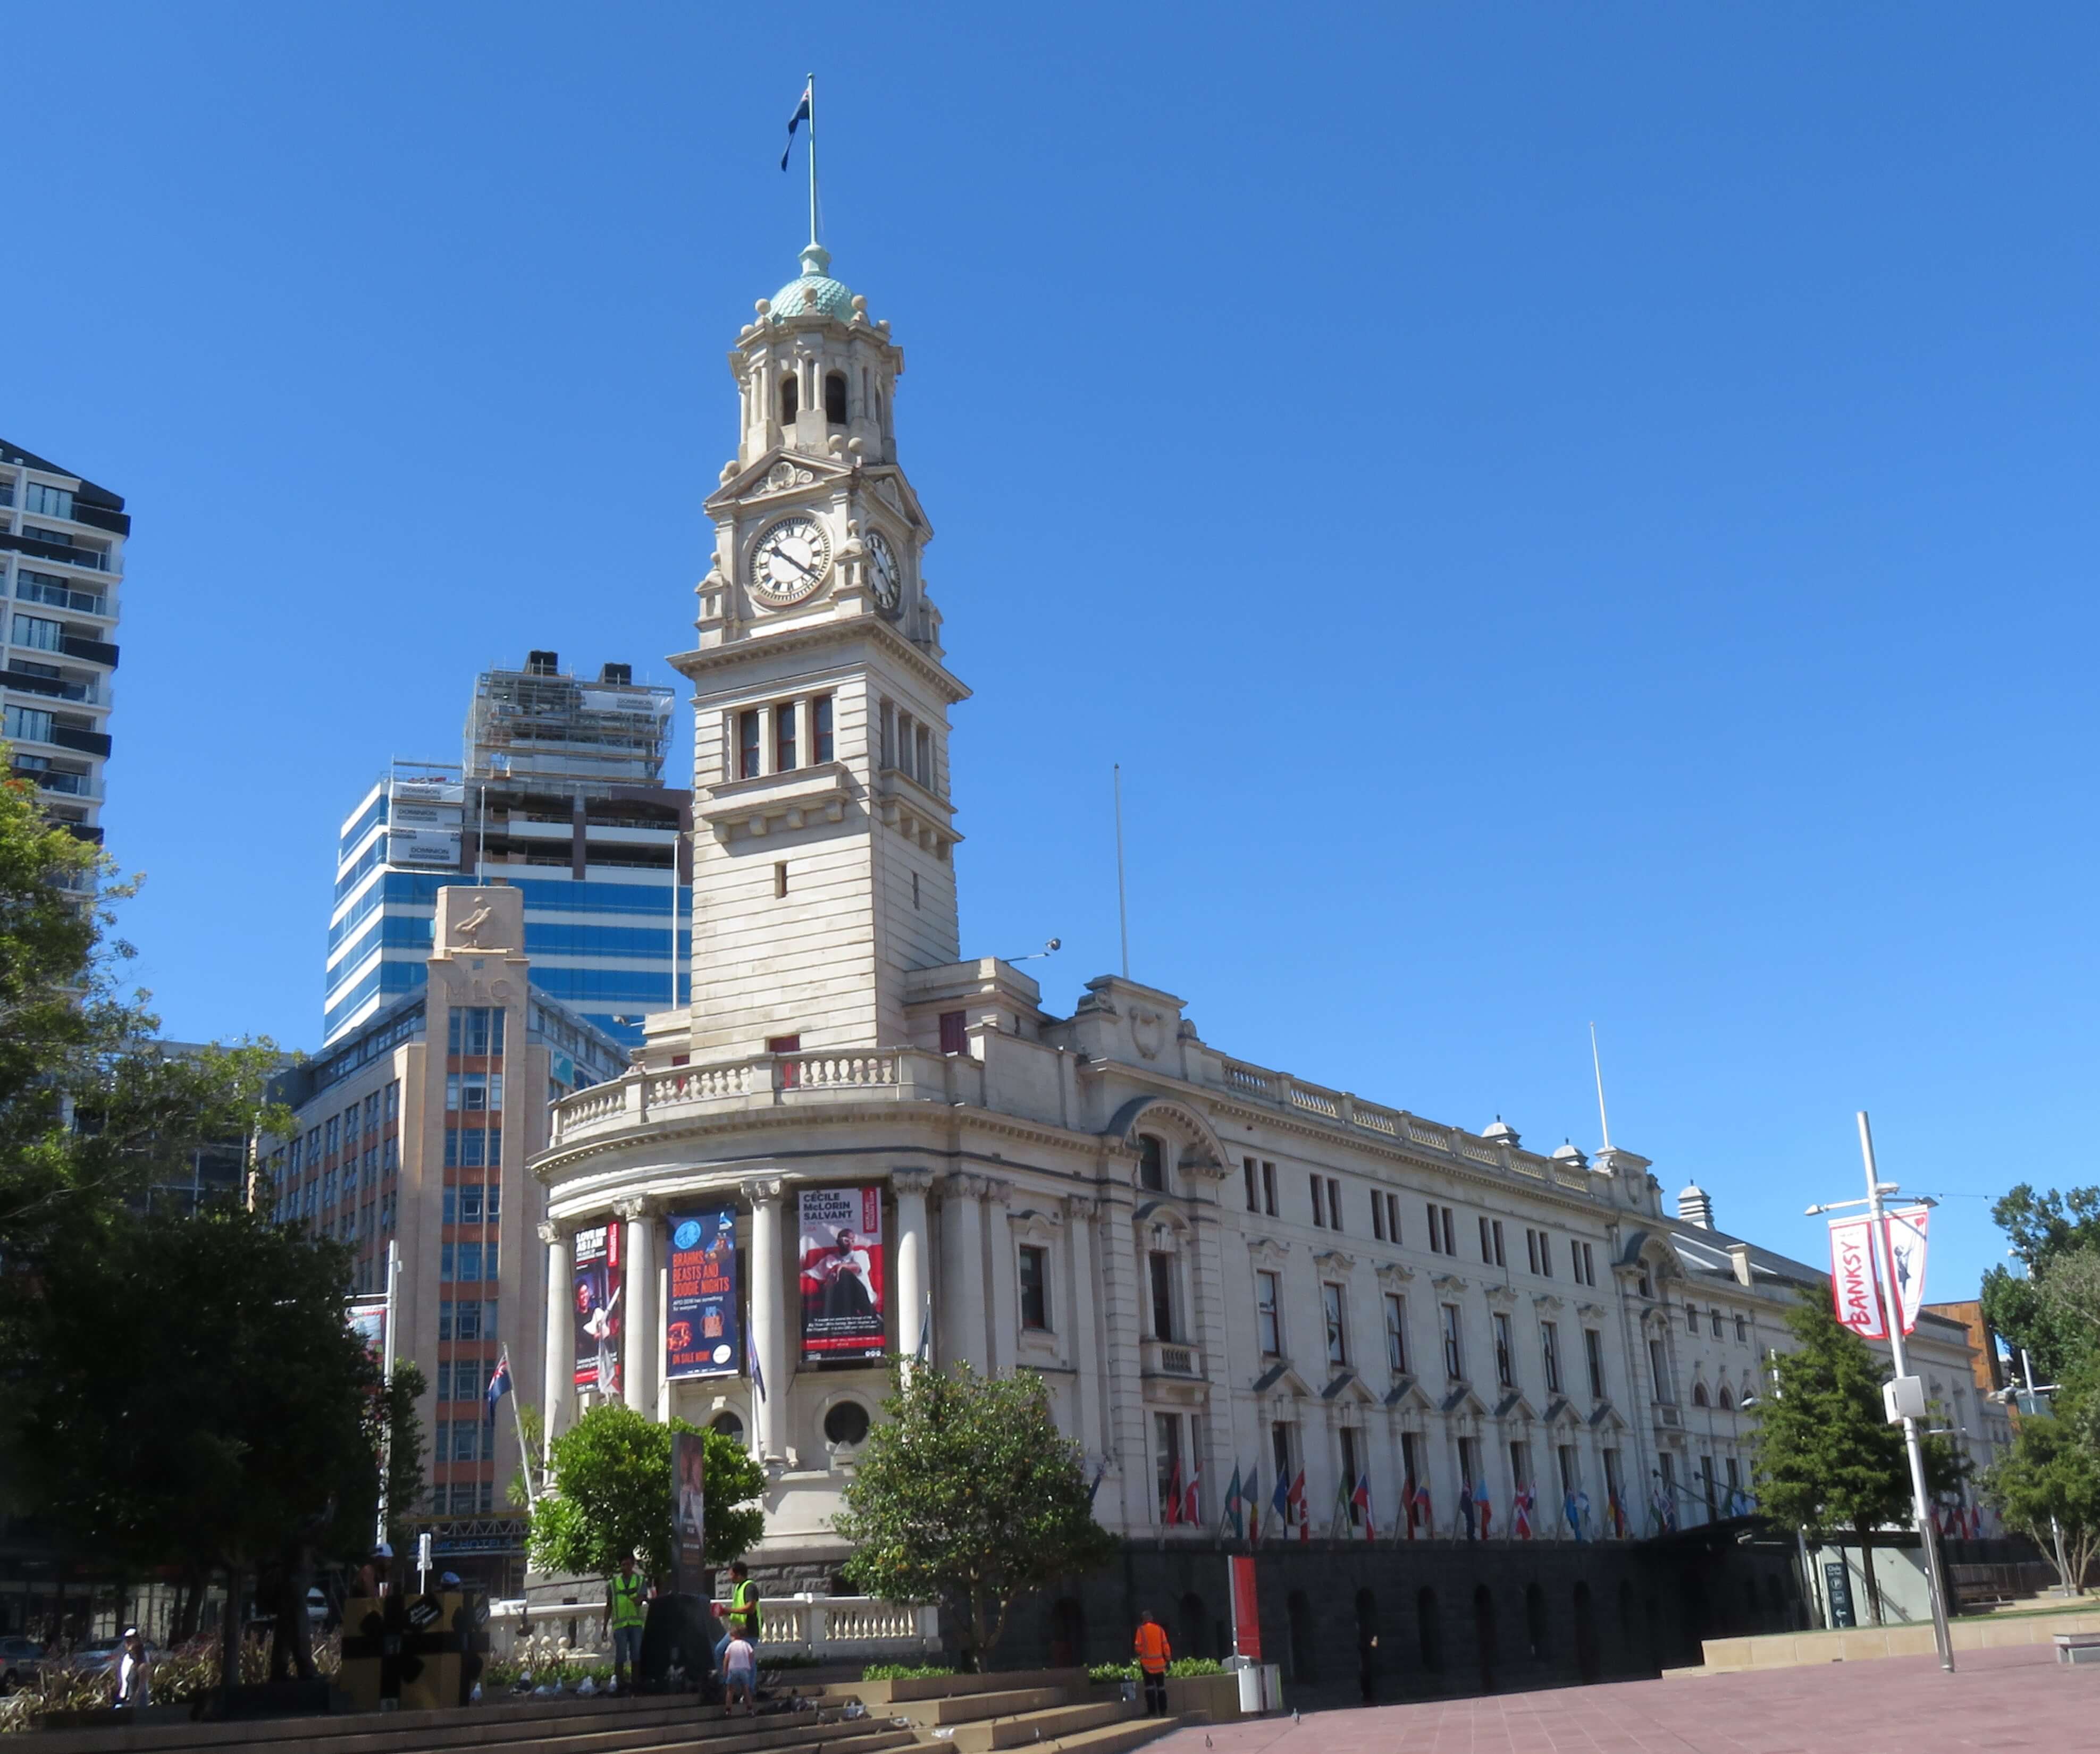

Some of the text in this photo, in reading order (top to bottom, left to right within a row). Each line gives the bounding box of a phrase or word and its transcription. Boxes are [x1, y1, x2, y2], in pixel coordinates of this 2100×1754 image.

[443, 978, 511, 1002] MLC
[803, 1192, 840, 1202] CÉCILE
[803, 1201, 850, 1211] McLORIN
[803, 1210, 853, 1220] SALVANT
[576, 1229, 595, 1243] LOVE
[576, 1241, 587, 1253] AS
[673, 1262, 719, 1282] BEASTS AND
[701, 1277, 730, 1293] NIGHTS
[1840, 1240, 1872, 1336] BANKSY
[459, 1538, 512, 1548] HOTELS
